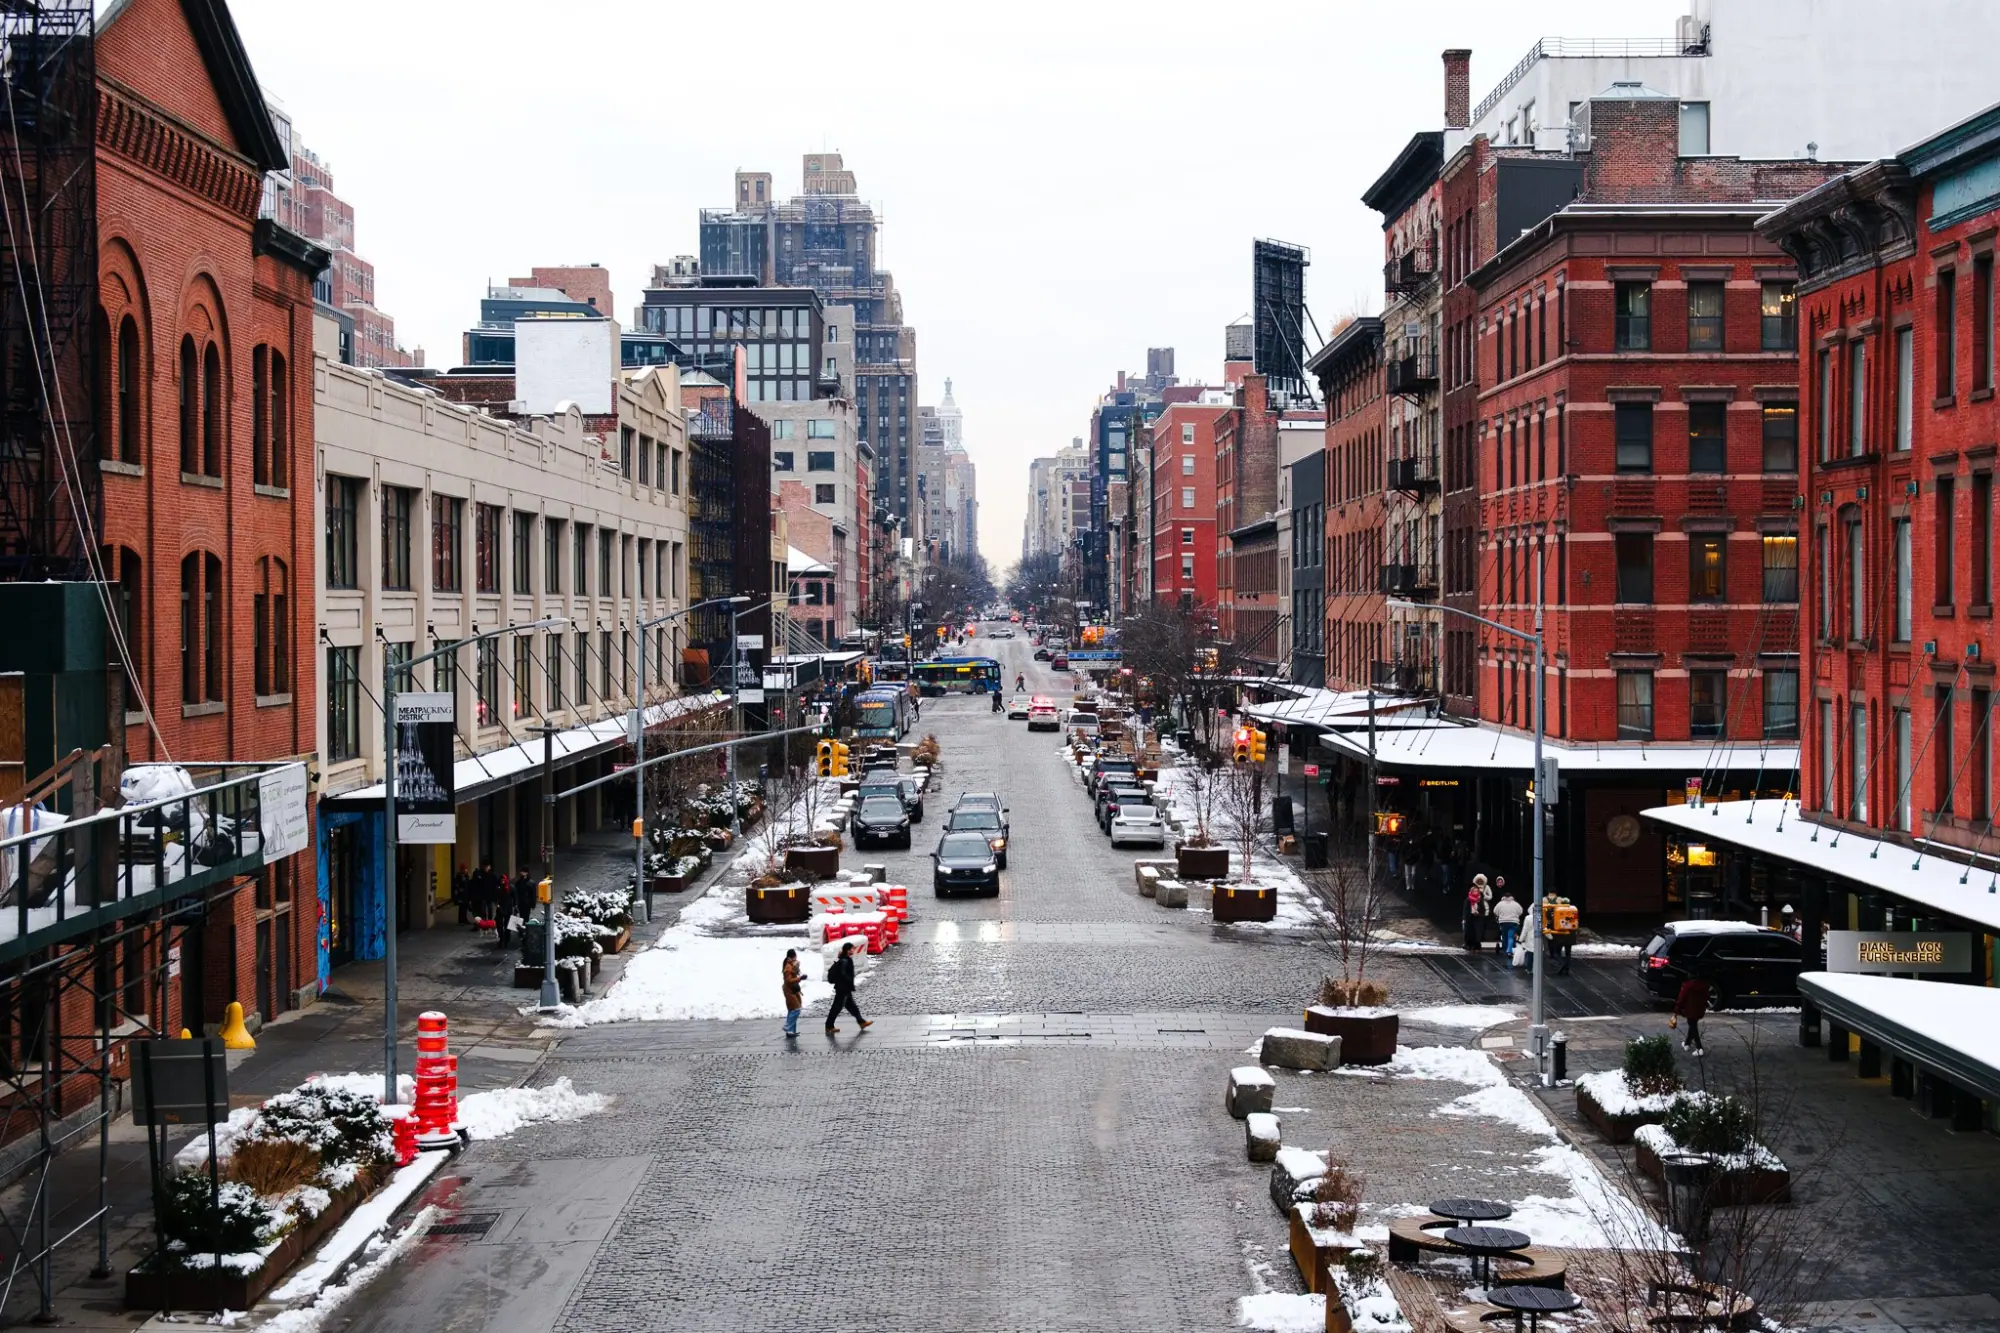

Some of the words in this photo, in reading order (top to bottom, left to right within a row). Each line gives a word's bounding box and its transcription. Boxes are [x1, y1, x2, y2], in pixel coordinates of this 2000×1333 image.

[398, 706, 452, 714] MEATPACKING
[1859, 942, 1895, 952] DIANE
[1917, 942, 1943, 952] VON
[1859, 952, 1943, 962] FURSTENBERG
